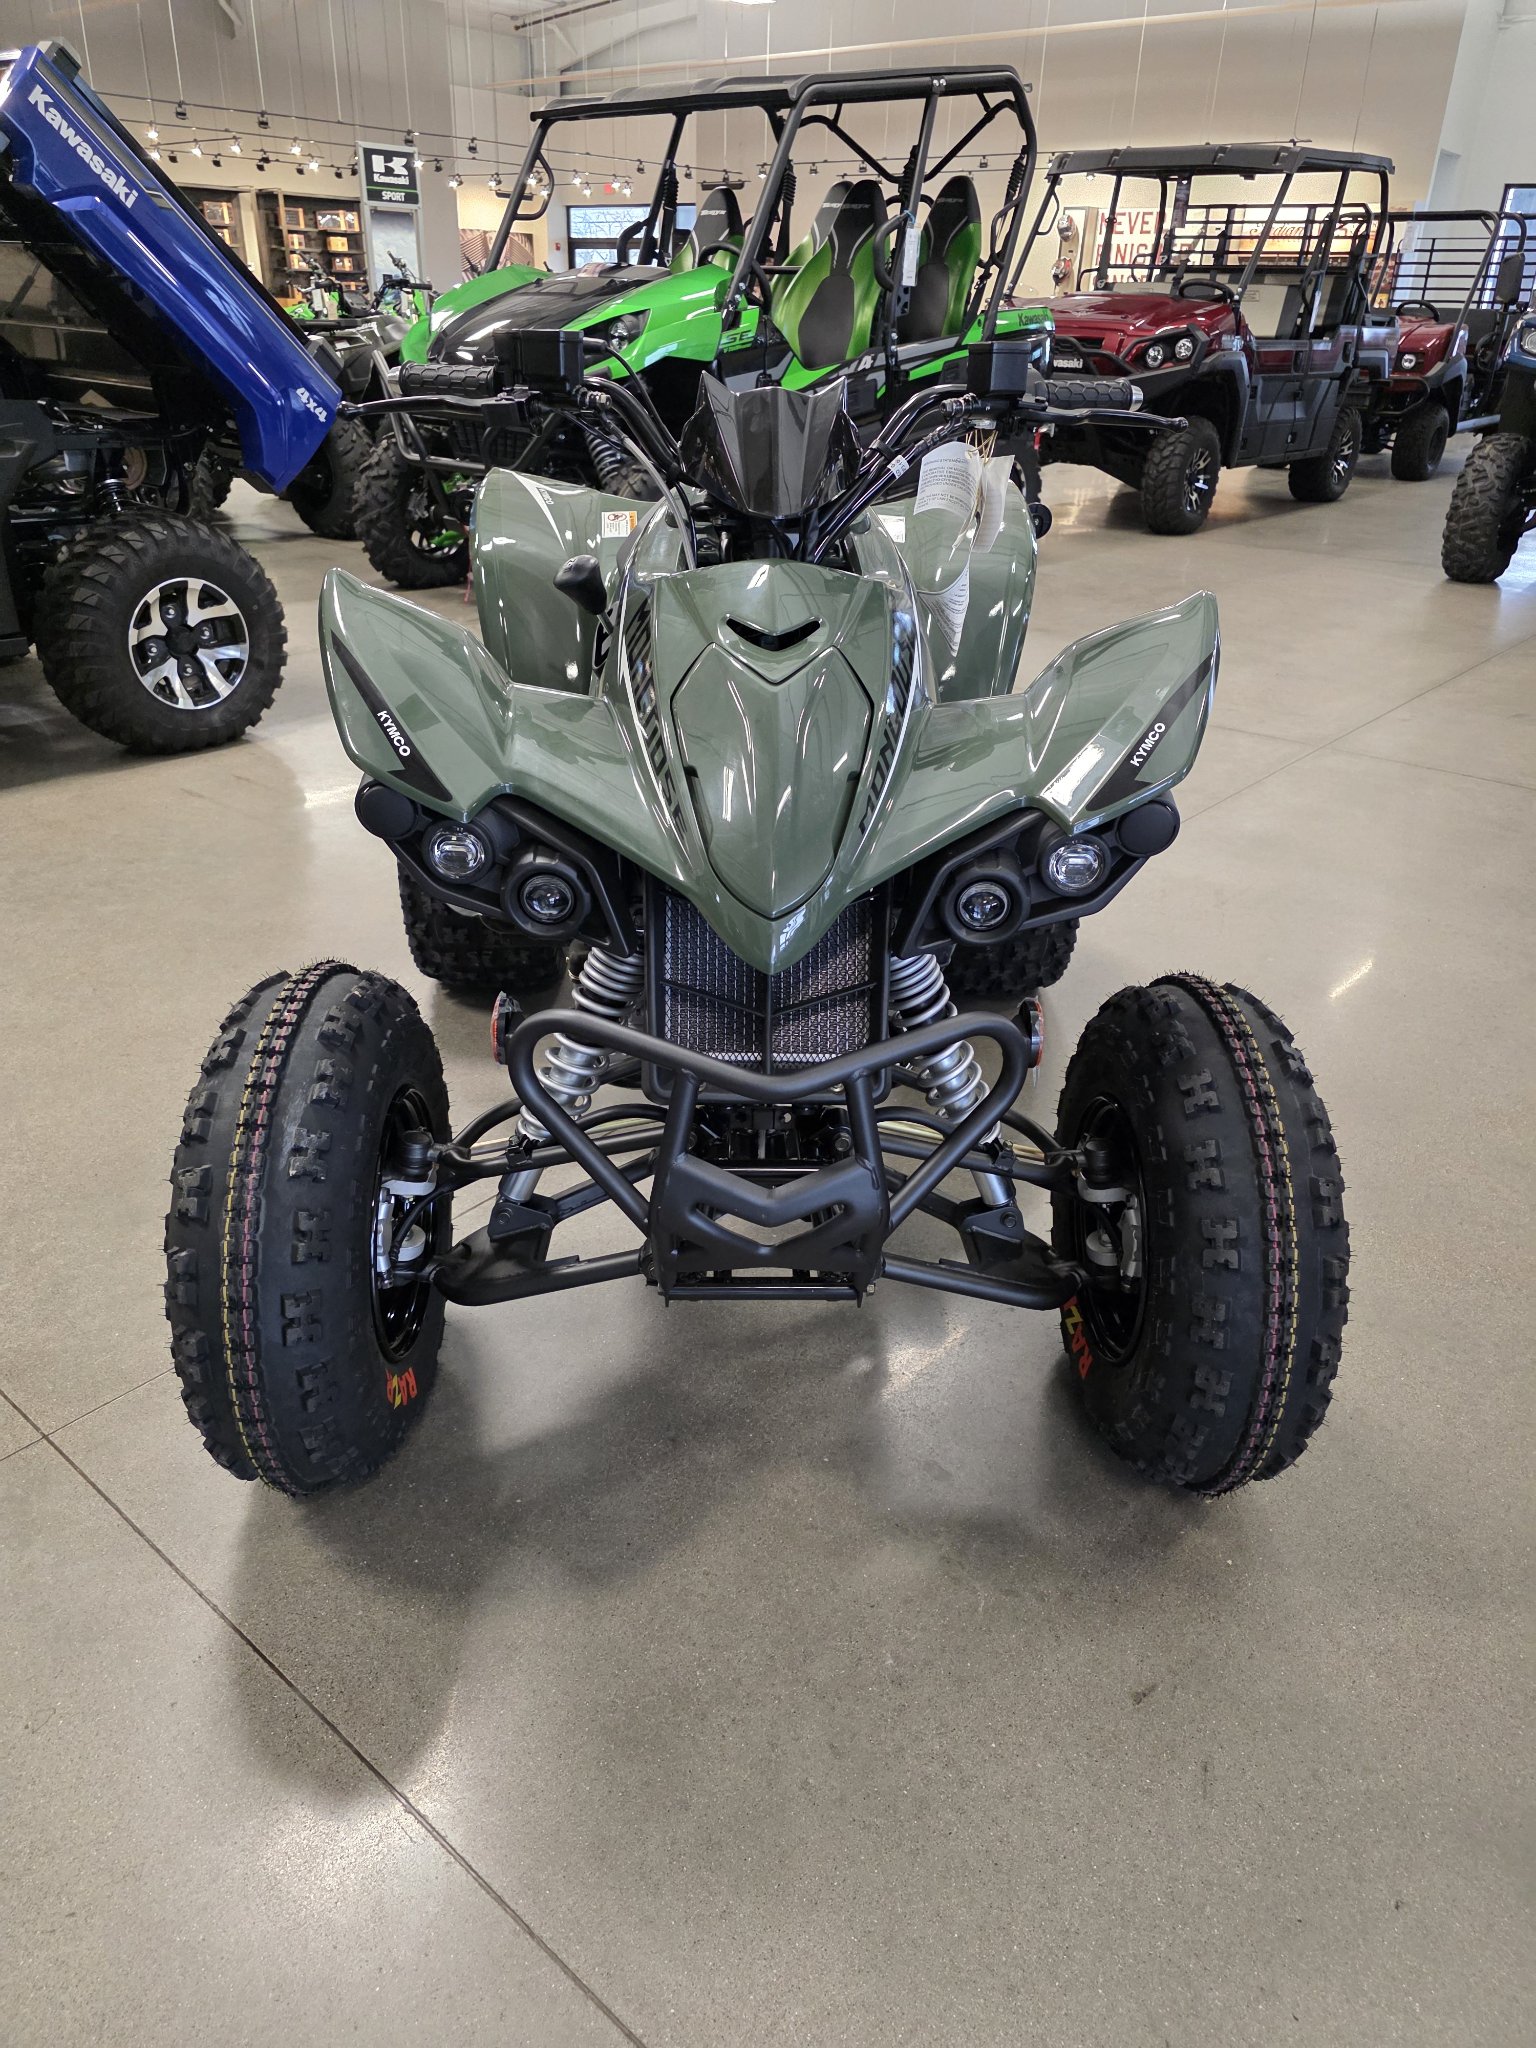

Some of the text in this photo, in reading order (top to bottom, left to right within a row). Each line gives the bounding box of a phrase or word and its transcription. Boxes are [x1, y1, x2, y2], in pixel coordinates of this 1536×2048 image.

[28, 84, 139, 209] Kawasaki
[381, 191, 406, 202] SPORT
[721, 329, 755, 346] SE
[295, 387, 328, 423] 4x4
[377, 710, 411, 757] KYMCO
[1130, 722, 1166, 767] KYMCO
